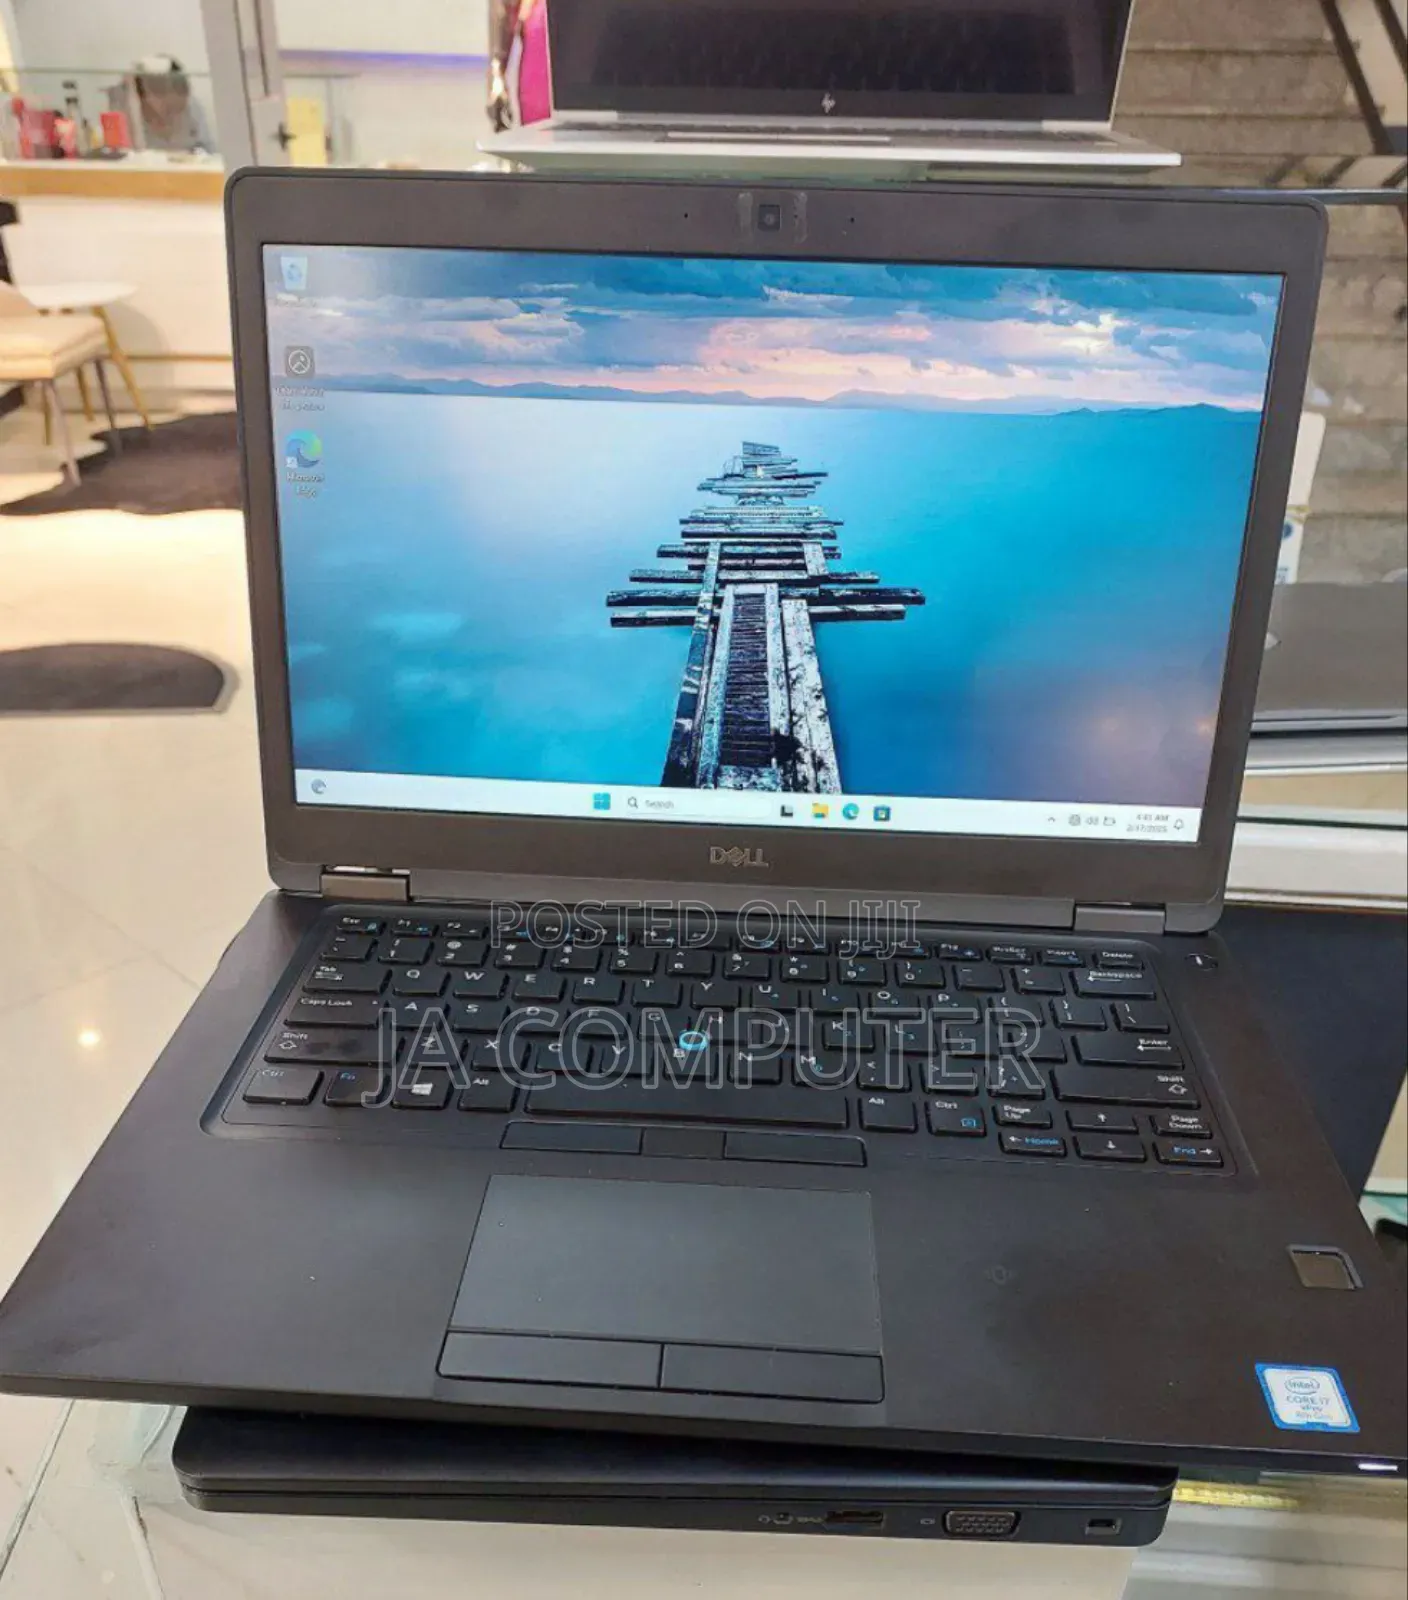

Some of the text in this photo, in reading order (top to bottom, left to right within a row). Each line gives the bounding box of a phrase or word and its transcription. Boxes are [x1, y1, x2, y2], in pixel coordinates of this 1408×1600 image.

[709, 845, 769, 868] DELL
[406, 969, 420, 979] Q
[464, 971, 484, 981] W
[524, 974, 537, 983] E
[583, 977, 596, 985] R
[642, 979, 654, 988] T
[701, 982, 713, 991] Y
[758, 984, 772, 994] U
[938, 993, 949, 1002] P
[404, 1002, 418, 1011] A
[466, 1004, 480, 1013] S
[832, 1021, 845, 1031] K
[282, 1032, 308, 1040] Shift
[485, 1040, 499, 1050] X
[738, 1053, 753, 1061] N
[801, 1055, 816, 1065] M
[868, 1097, 885, 1105] Alt
[935, 1101, 958, 1110] Ctrl
[1024, 1137, 1059, 1145] Home
[1174, 1147, 1196, 1155] End
